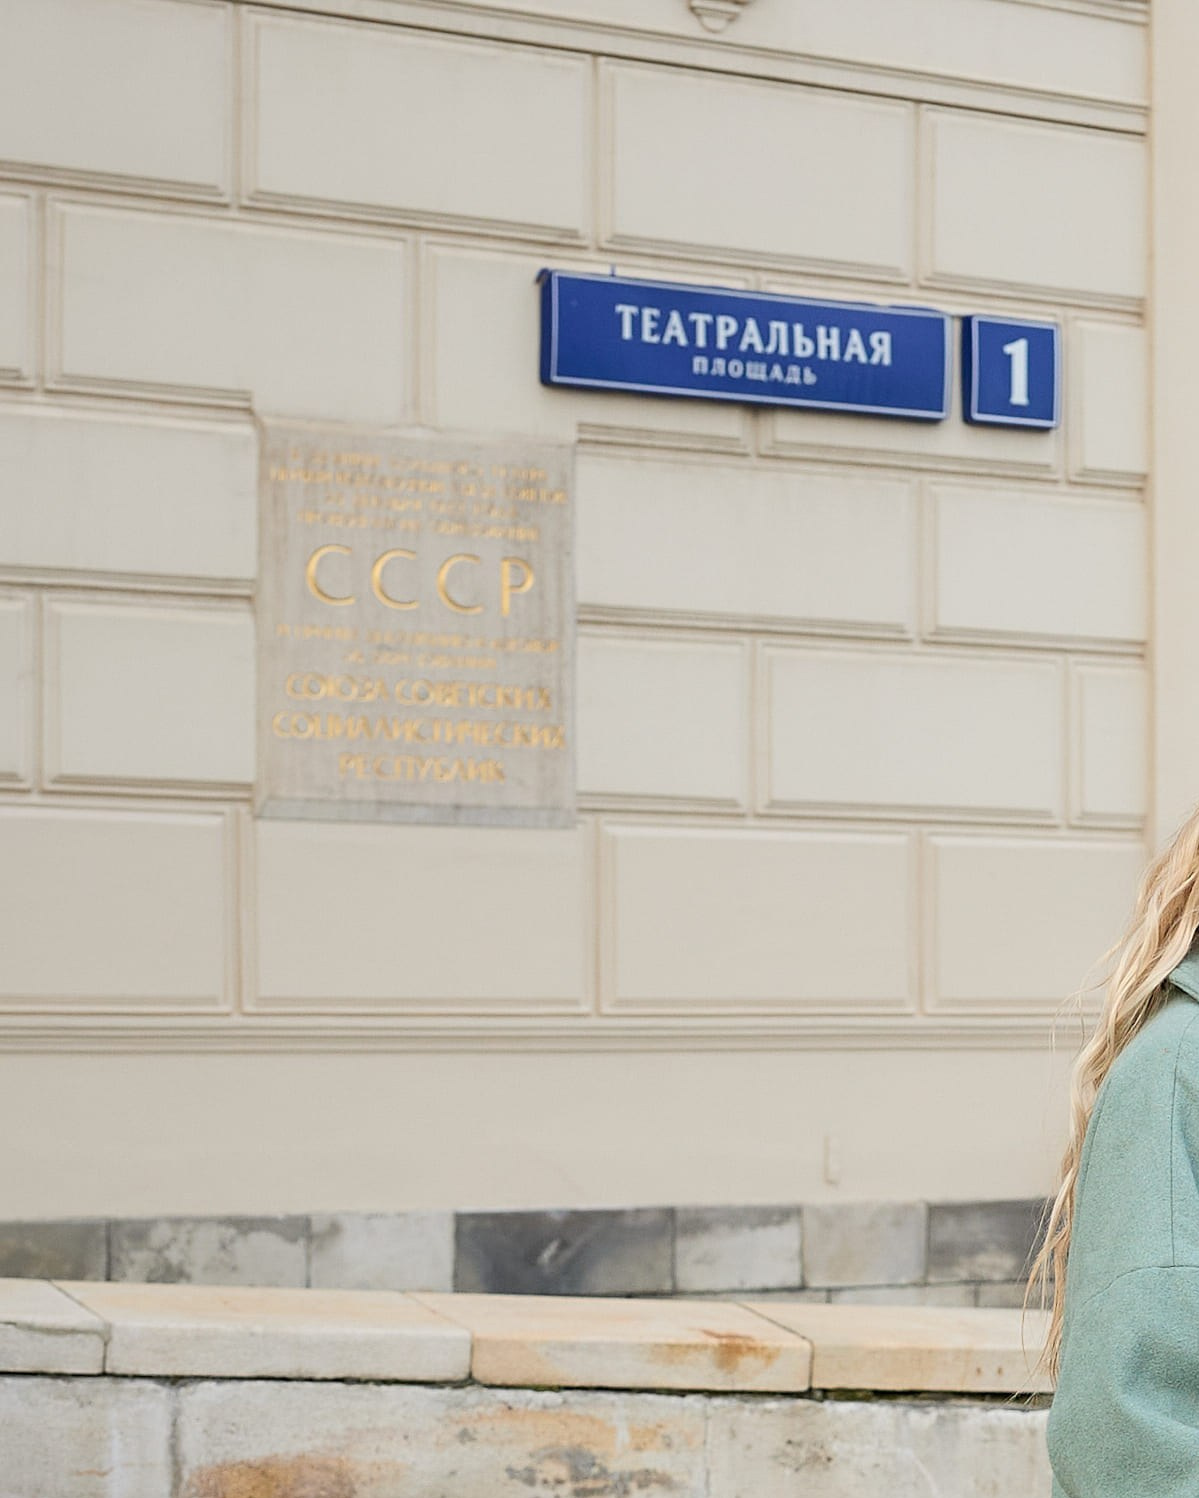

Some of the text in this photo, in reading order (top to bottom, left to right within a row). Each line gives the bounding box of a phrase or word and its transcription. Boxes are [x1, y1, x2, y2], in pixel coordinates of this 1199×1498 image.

[615, 303, 893, 366] ТЕАТРАЛЬНАЯ
[693, 357, 817, 385] ПЛОЩАДЬ
[1002, 338, 1030, 406] 1
[305, 543, 535, 616] СССР
[286, 672, 389, 702] СОЮЗА
